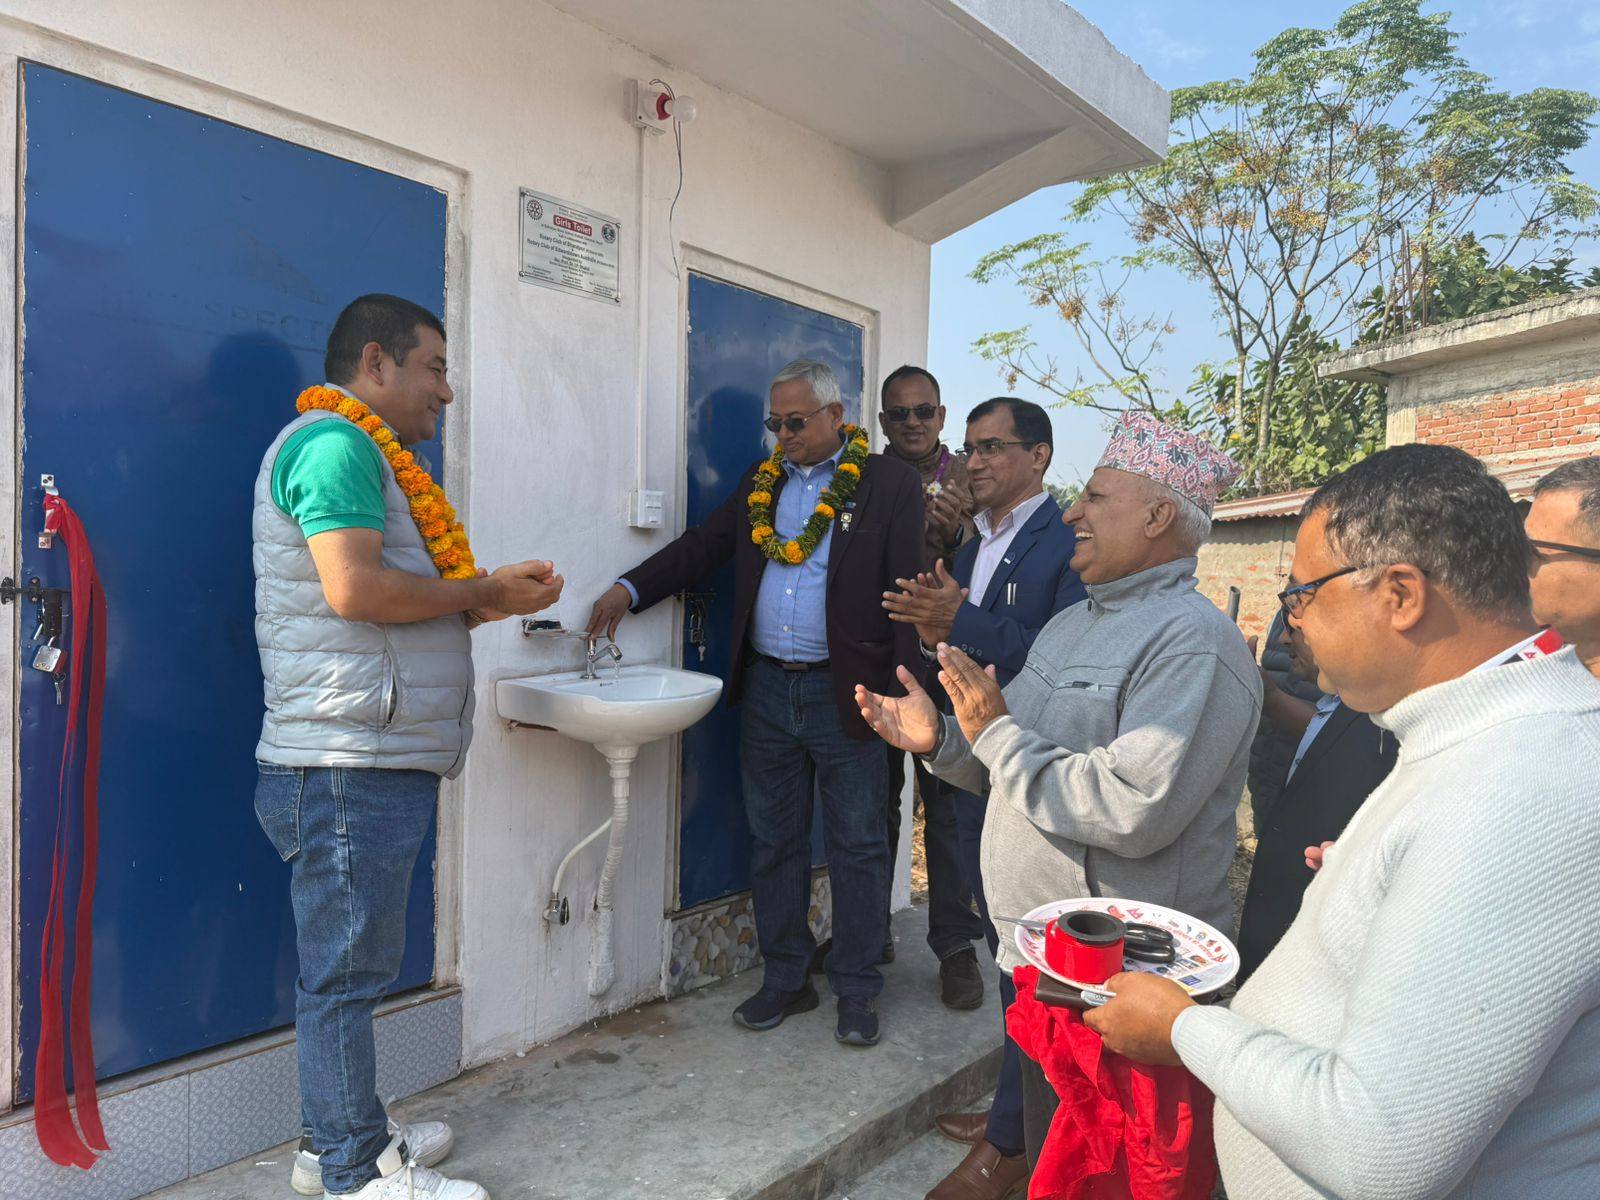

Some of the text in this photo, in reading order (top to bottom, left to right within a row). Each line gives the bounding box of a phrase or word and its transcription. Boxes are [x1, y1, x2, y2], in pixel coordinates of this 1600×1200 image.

[555, 217, 572, 228] Girls
[572, 222, 591, 235] Toilet
[527, 238, 540, 247] Rotary
